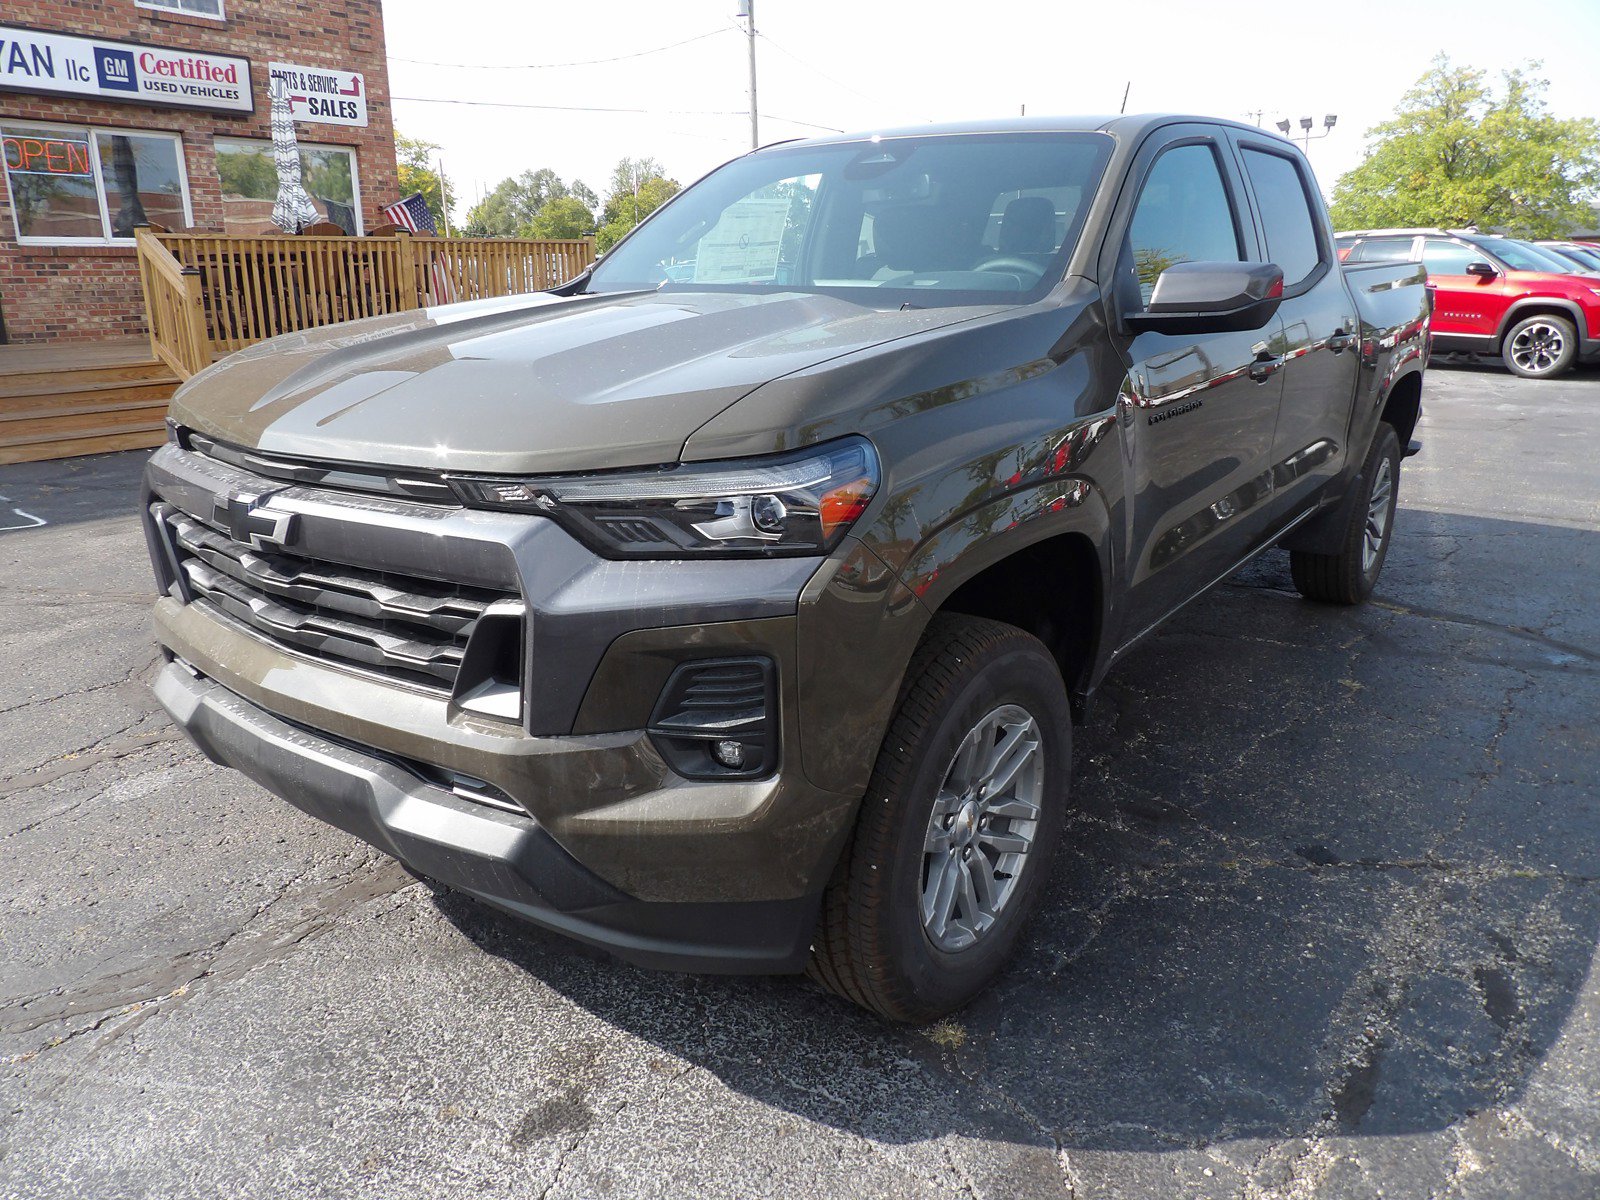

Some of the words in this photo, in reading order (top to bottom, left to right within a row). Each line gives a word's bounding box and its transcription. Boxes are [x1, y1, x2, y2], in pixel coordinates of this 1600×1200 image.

[103, 56, 128, 77] GM
[140, 52, 238, 84] Certified
[144, 80, 178, 93] USED
[180, 84, 240, 100] VEHICLES
[300, 72, 306, 91] &
[308, 73, 339, 95] SERVICE
[308, 97, 358, 119] SALES
[2, 138, 89, 173] OPEN
